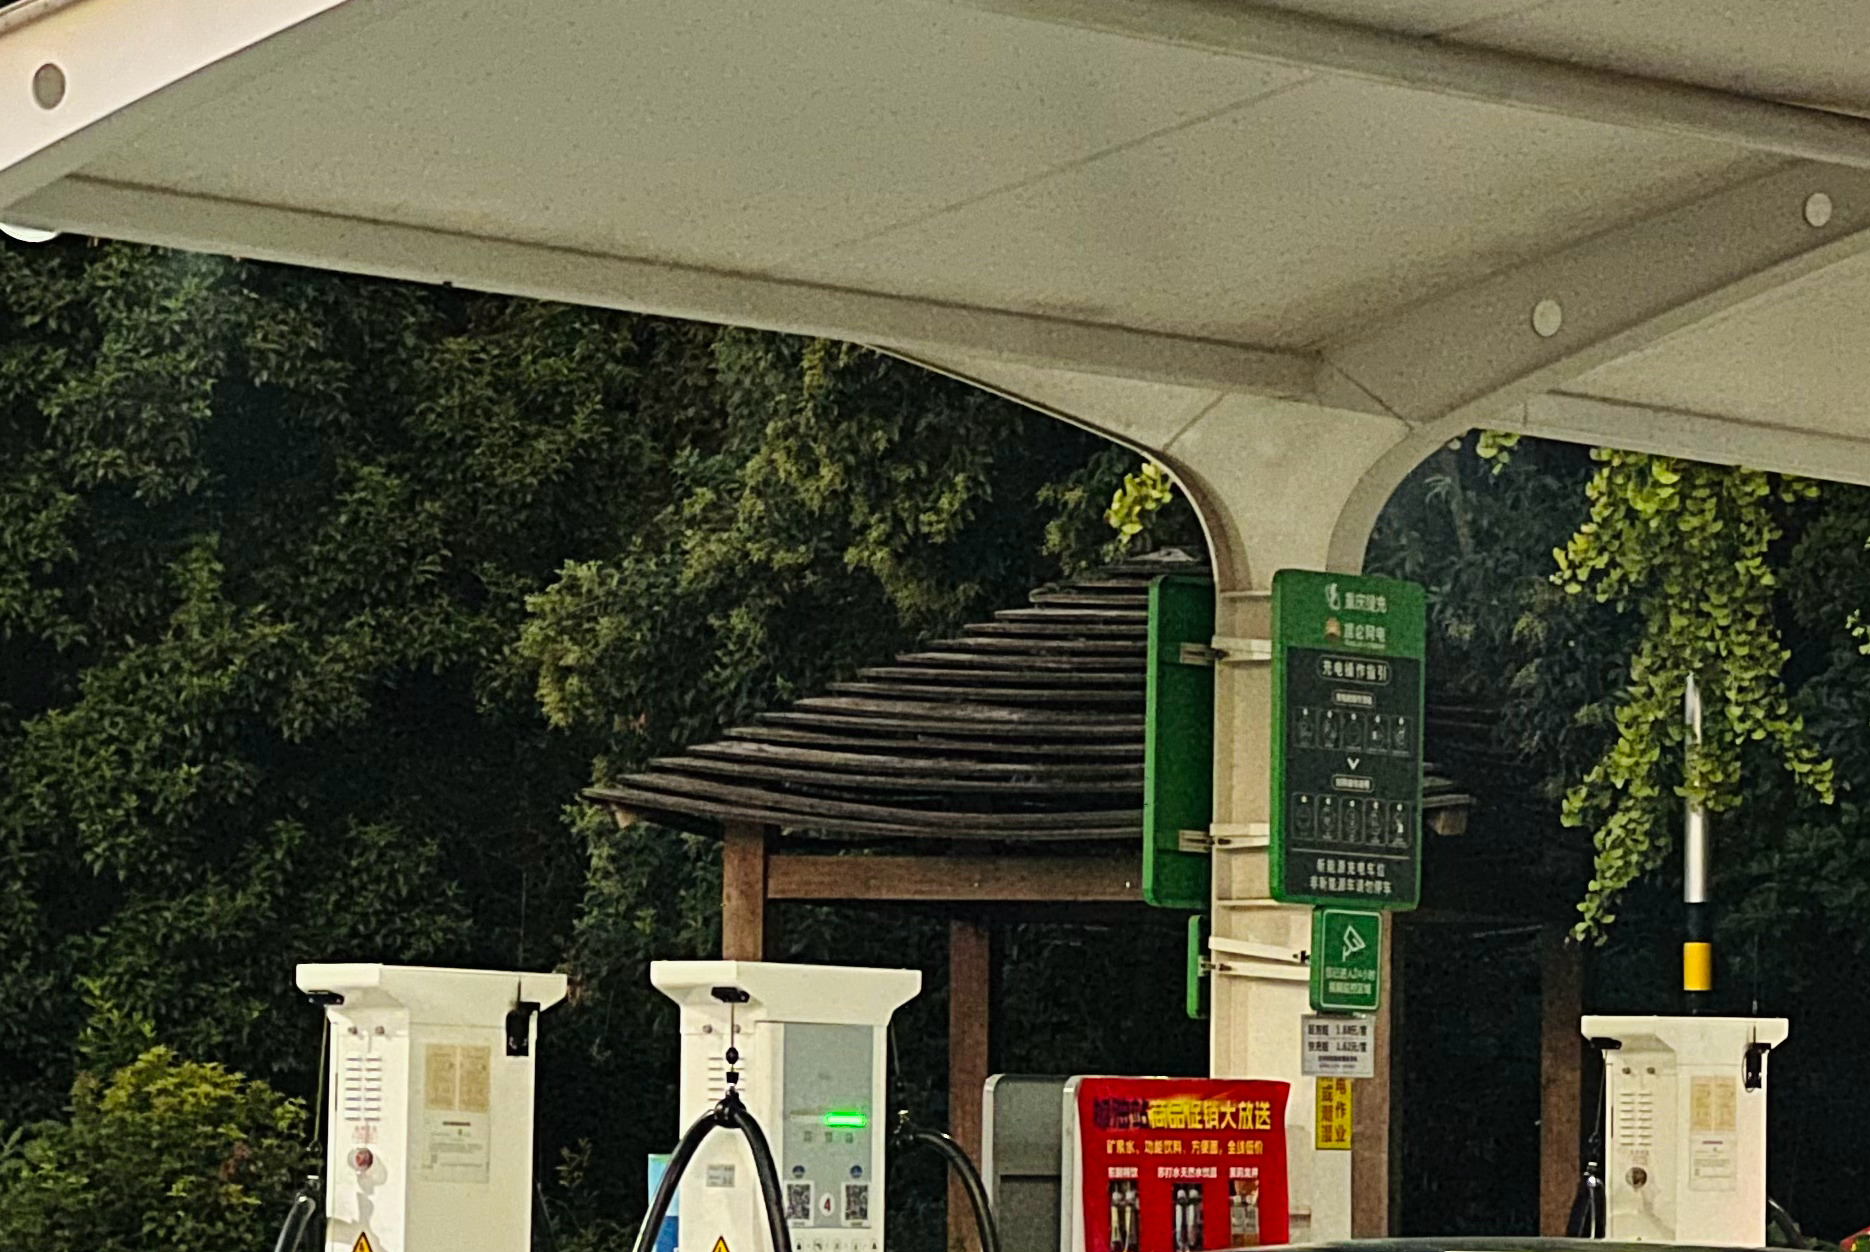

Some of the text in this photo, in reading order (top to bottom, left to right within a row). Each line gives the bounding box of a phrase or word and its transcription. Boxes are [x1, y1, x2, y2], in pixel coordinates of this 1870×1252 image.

[1148, 1100, 1271, 1129] 商品促销大放送
[824, 1198, 831, 1212] 4
